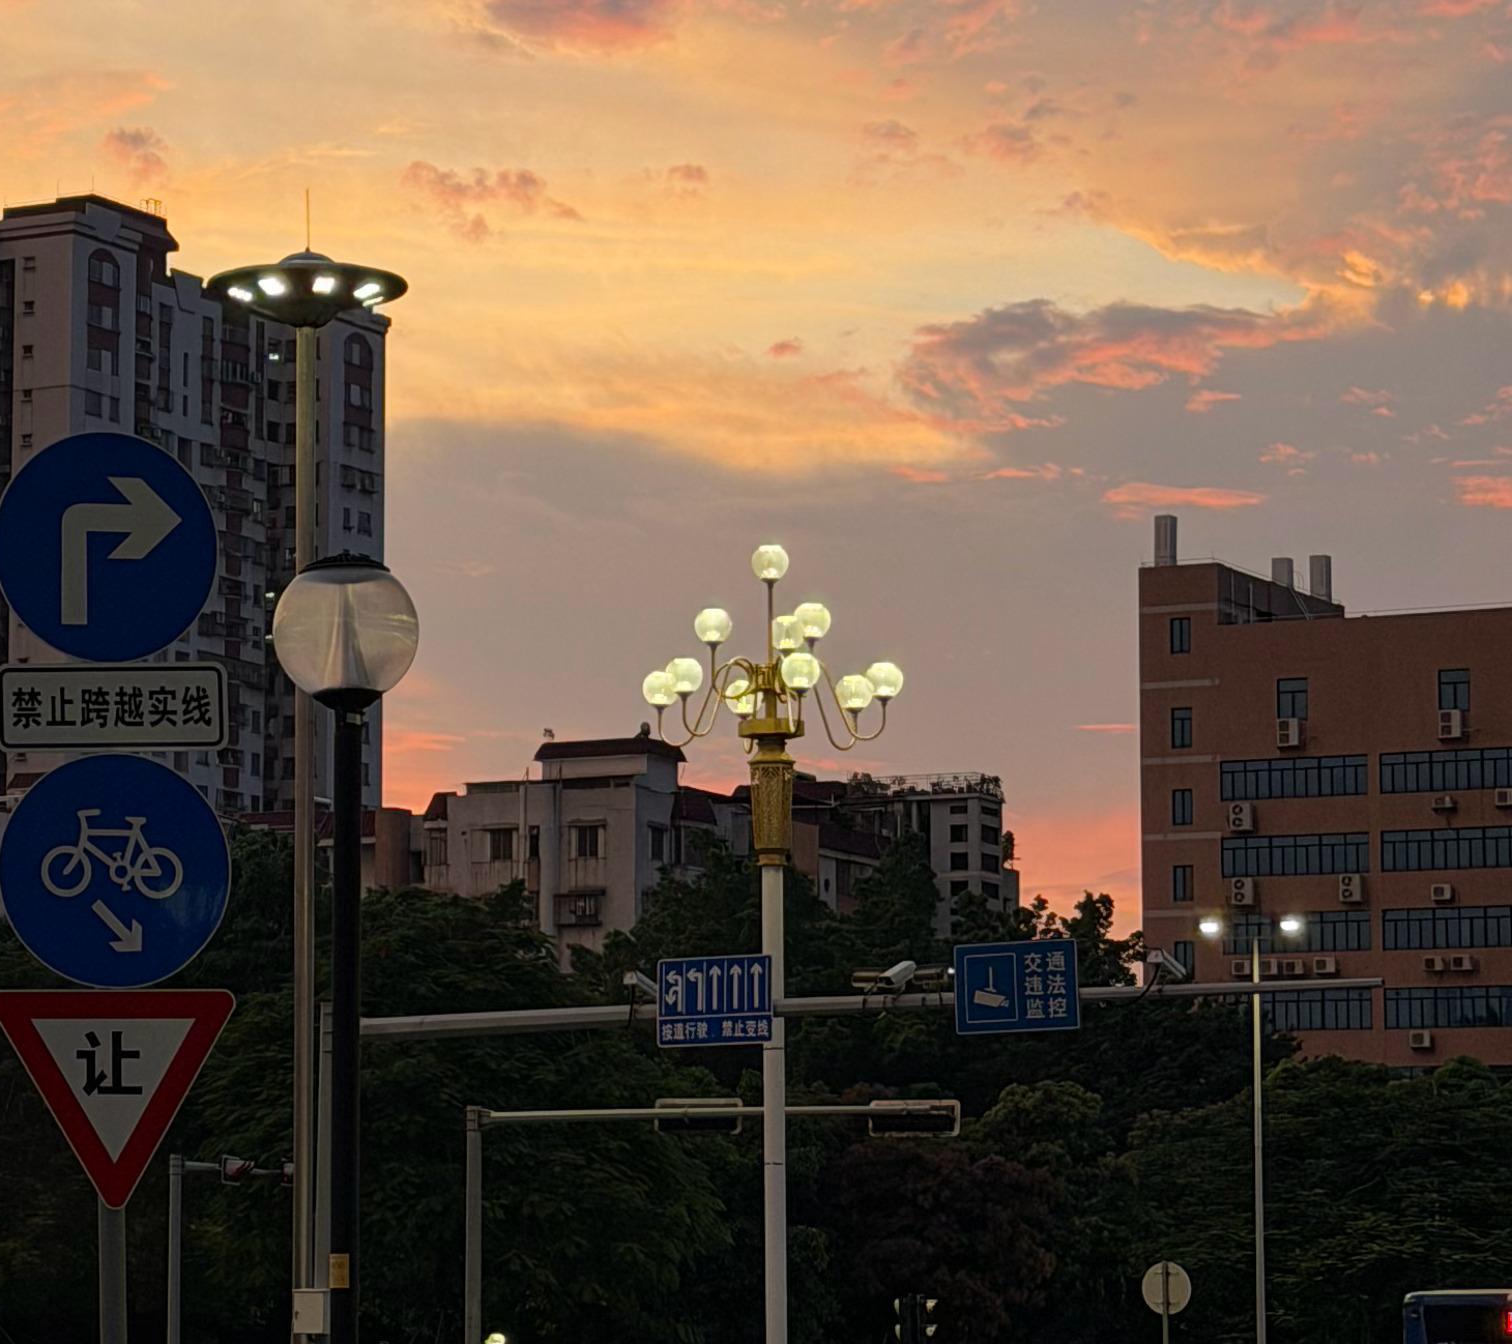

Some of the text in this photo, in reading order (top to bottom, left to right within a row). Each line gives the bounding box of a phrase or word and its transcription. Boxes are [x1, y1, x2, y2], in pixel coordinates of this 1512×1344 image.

[12, 686, 212, 729] 禁止跨越实线
[1024, 950, 1066, 973] 交通
[1024, 973, 1067, 996] 违法
[1025, 996, 1069, 1019] 监控
[76, 1031, 143, 1096] 让
